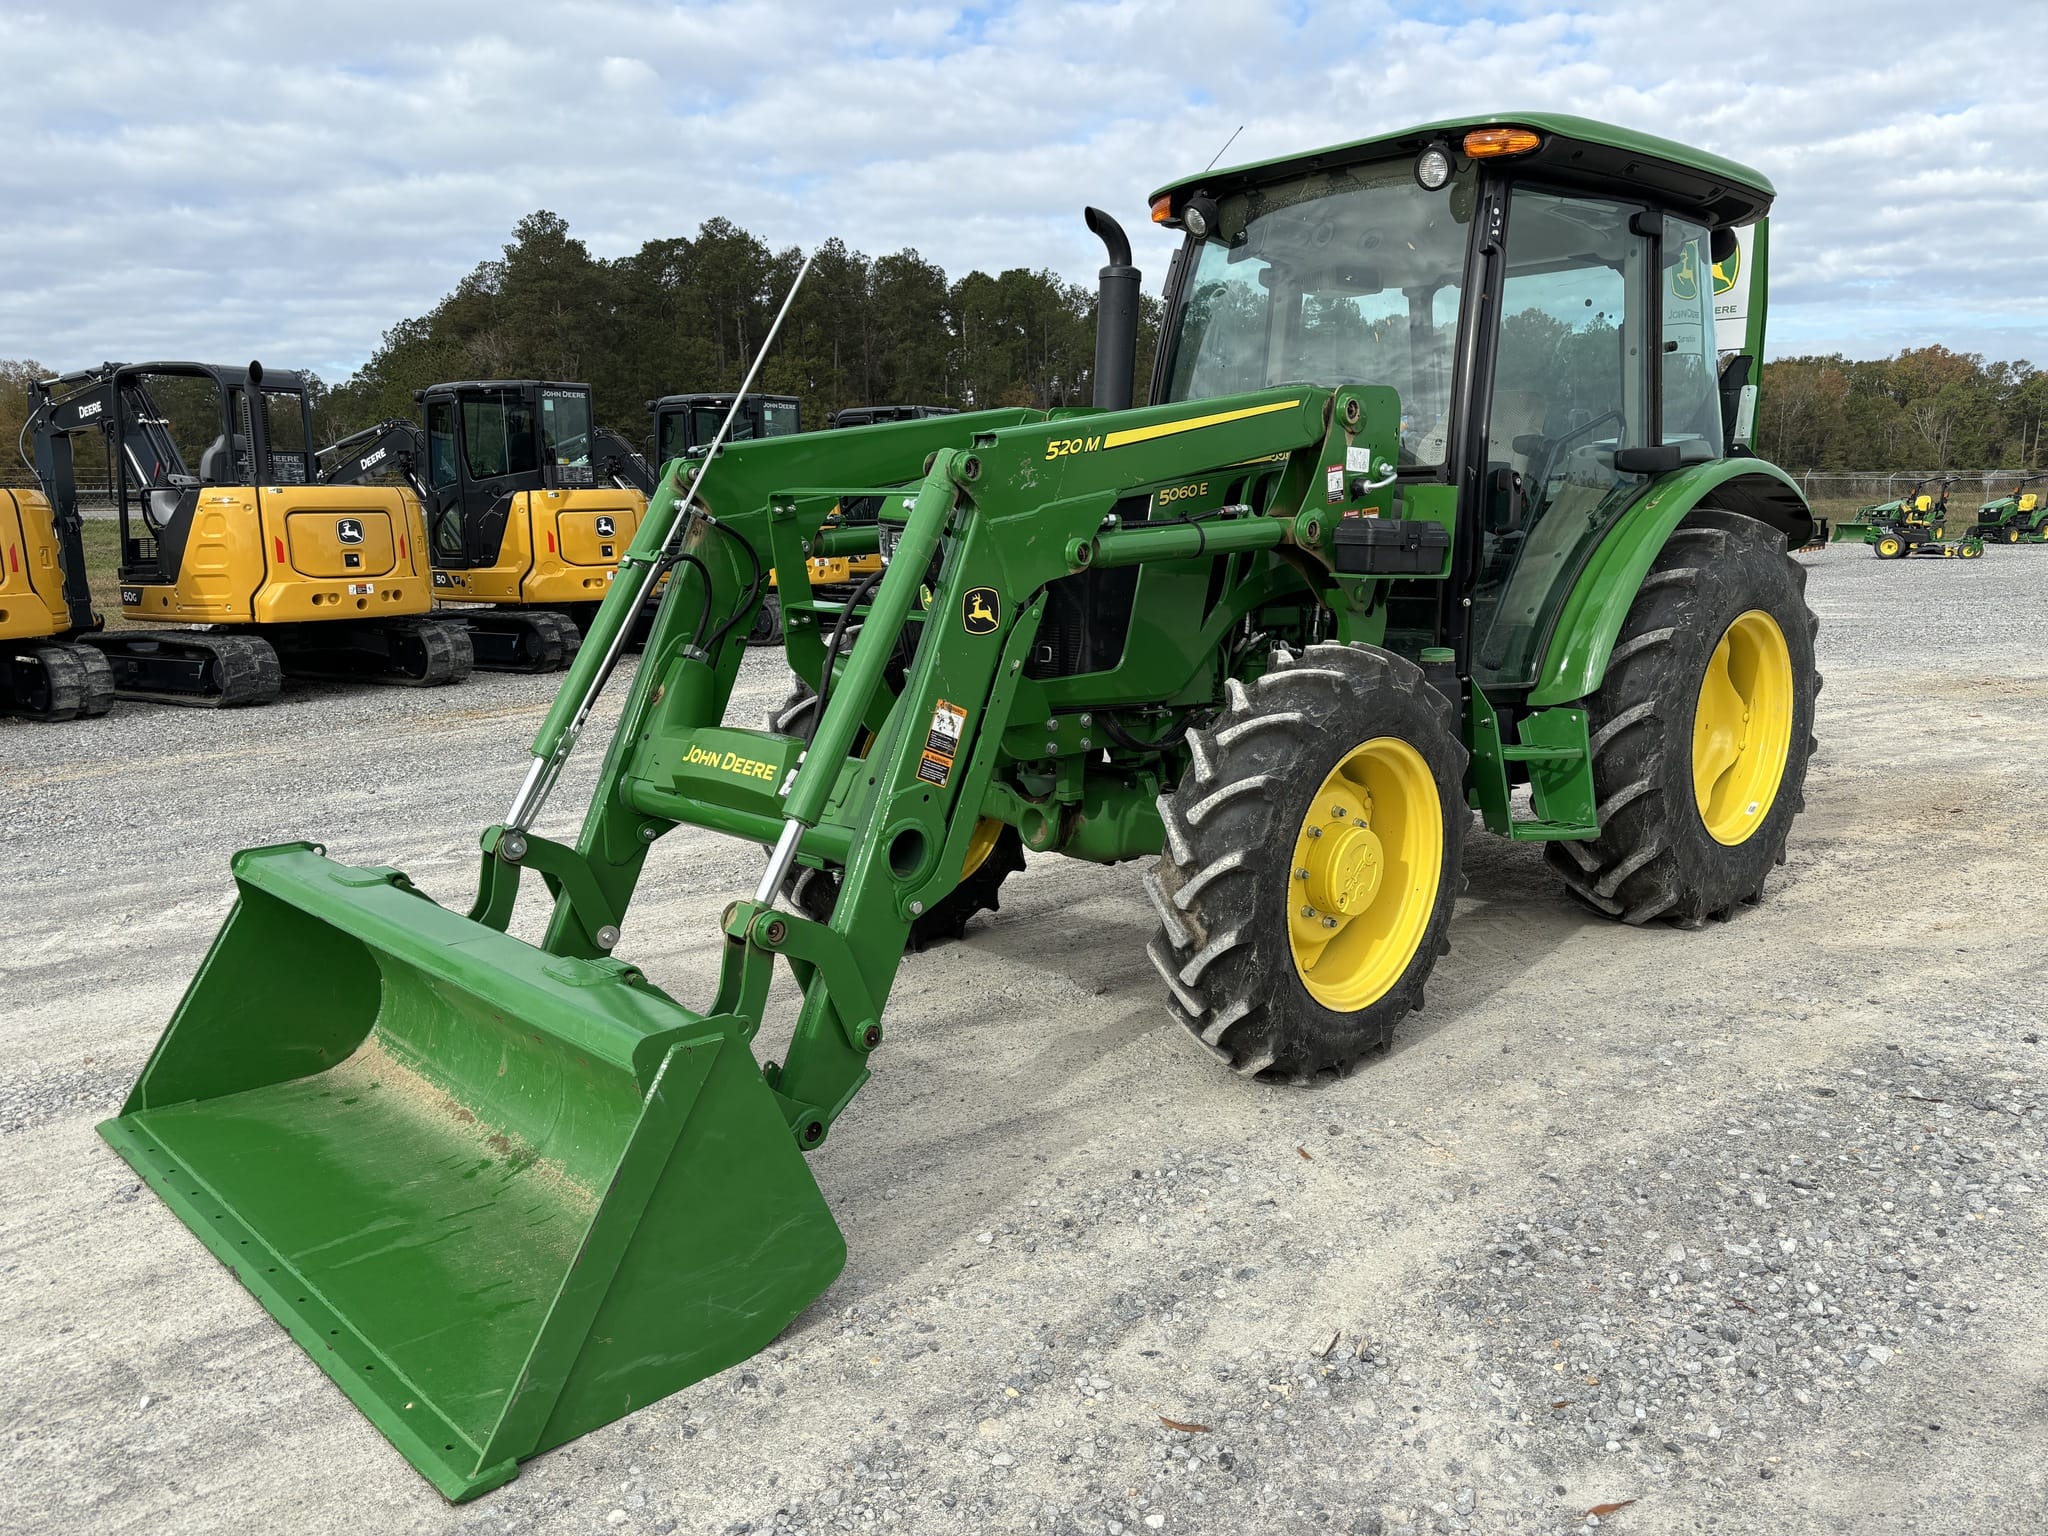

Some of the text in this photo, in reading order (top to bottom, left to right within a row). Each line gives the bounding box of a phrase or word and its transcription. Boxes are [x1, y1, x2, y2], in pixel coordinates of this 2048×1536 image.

[1714, 305, 1738, 315] ERE
[541, 389, 586, 399] JOHN DEERE
[78, 401, 103, 419] DEERE
[763, 401, 778, 409] JOHN
[1045, 435, 1101, 461] 520 M
[360, 447, 387, 470] DEERE
[1159, 482, 1209, 506] 5060 E
[436, 575, 447, 584] 50
[123, 591, 137, 602] 60G
[682, 744, 778, 781] JOHN DEERE
